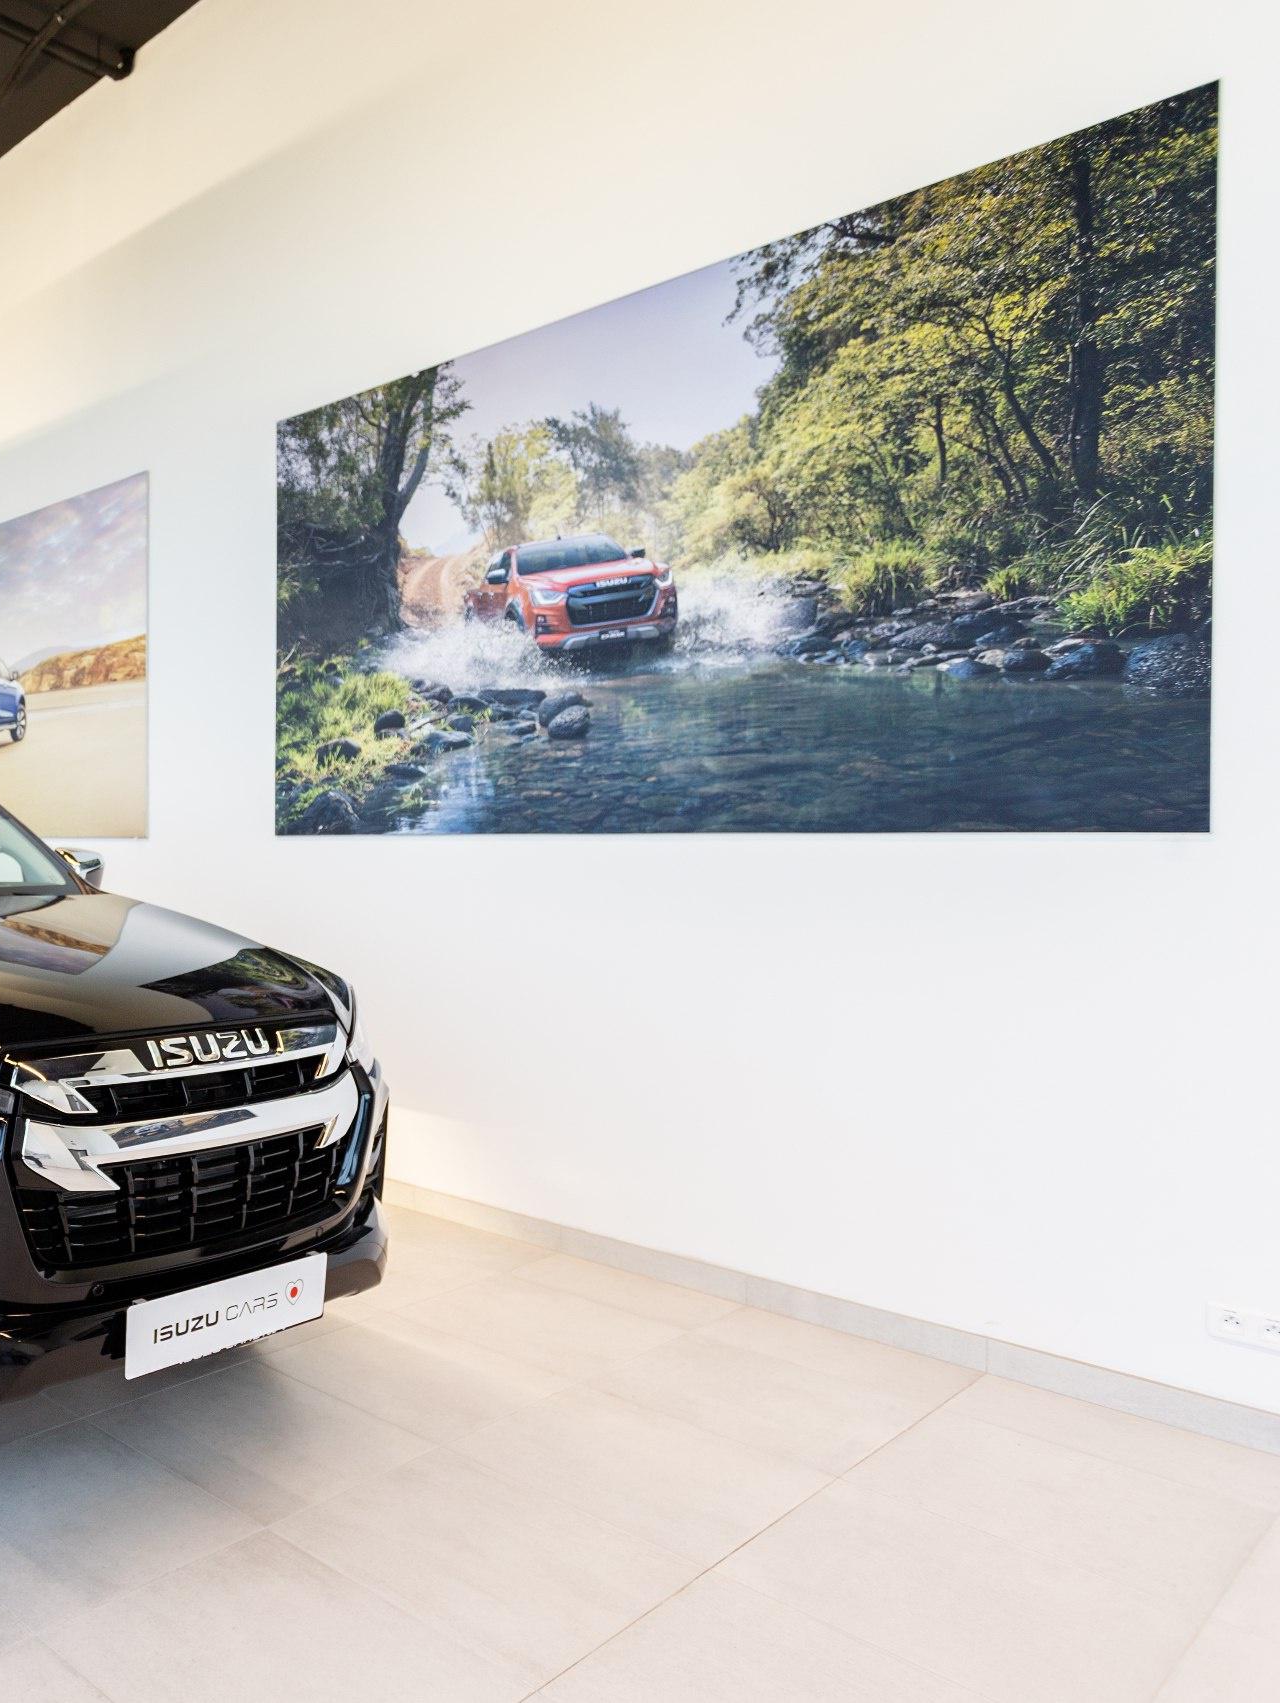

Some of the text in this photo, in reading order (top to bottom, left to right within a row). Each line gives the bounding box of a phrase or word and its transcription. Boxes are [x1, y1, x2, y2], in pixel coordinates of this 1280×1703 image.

[146, 1027, 270, 1068] ISUZU
[153, 1292, 279, 1344] ISUZU CARS
